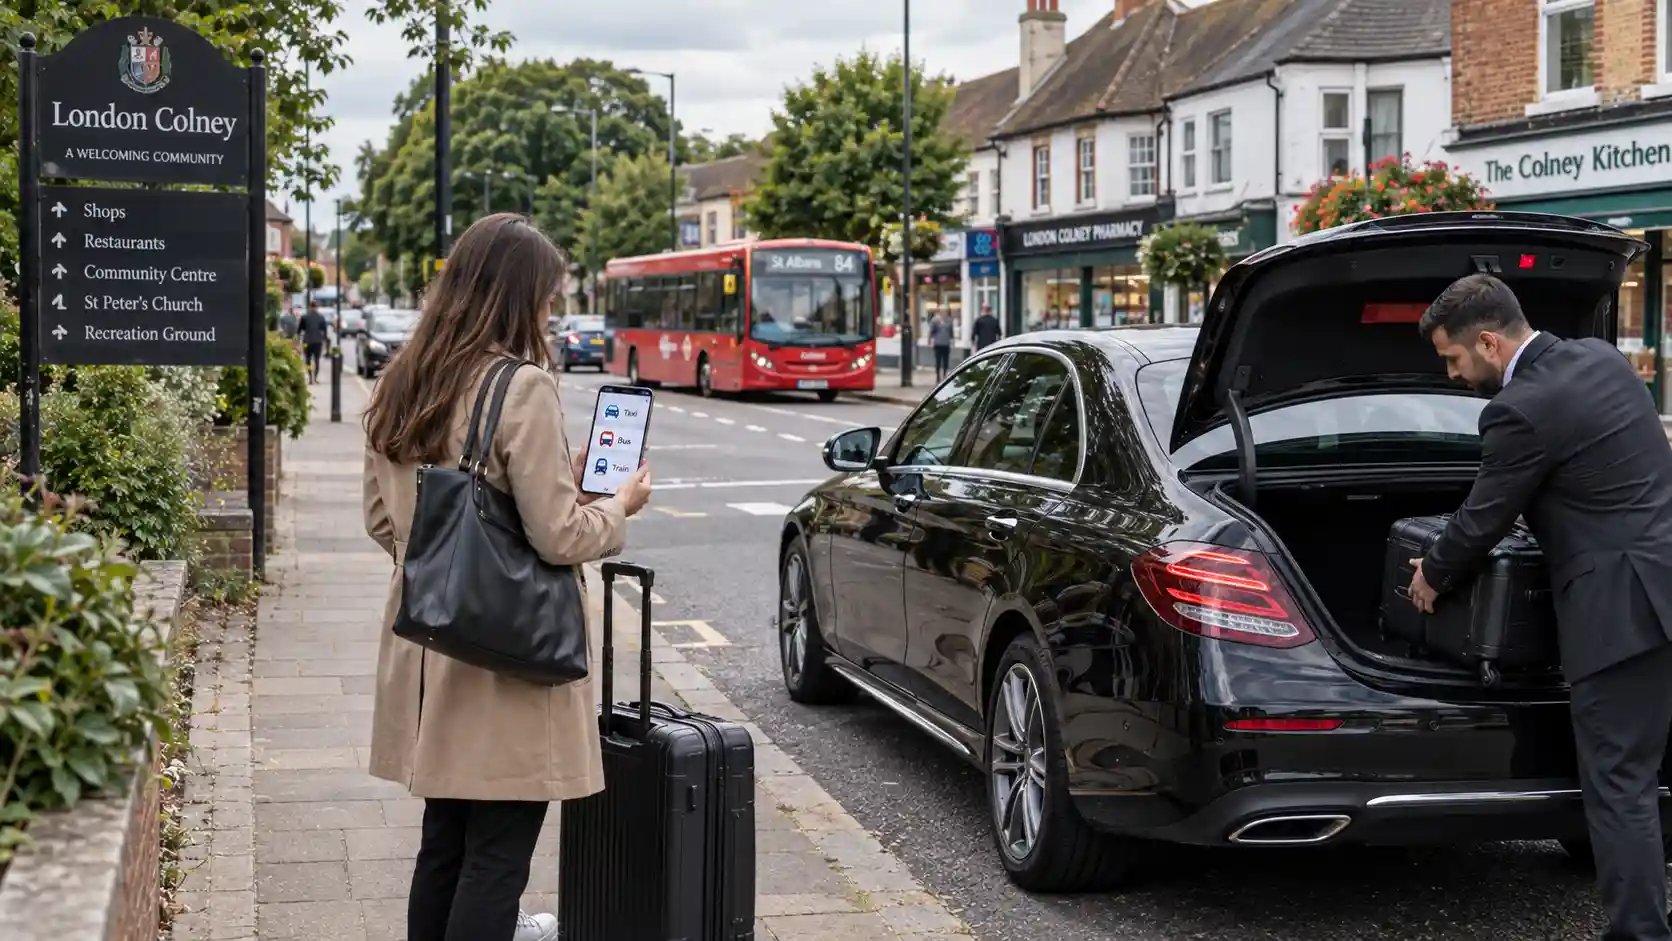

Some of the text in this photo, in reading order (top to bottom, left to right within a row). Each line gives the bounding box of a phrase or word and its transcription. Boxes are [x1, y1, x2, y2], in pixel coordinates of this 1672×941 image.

[52, 101, 237, 141] London Colney
[65, 148, 224, 165] A WELCOMING COMMUNITY
[1485, 140, 1671, 183] The Colney Kitchen
[83, 203, 126, 223] Shops
[83, 233, 165, 250] Restaurants
[1023, 221, 1144, 247] LONDON COLNEY PHARMACY
[835, 254, 853, 272] 84
[84, 264, 217, 284] Community Centre
[84, 295, 203, 312] St Peter's Church
[84, 325, 216, 342] Recreation Ground
[624, 409, 638, 417] Taxi
[618, 437, 631, 445] Bus
[612, 464, 629, 472] Train
